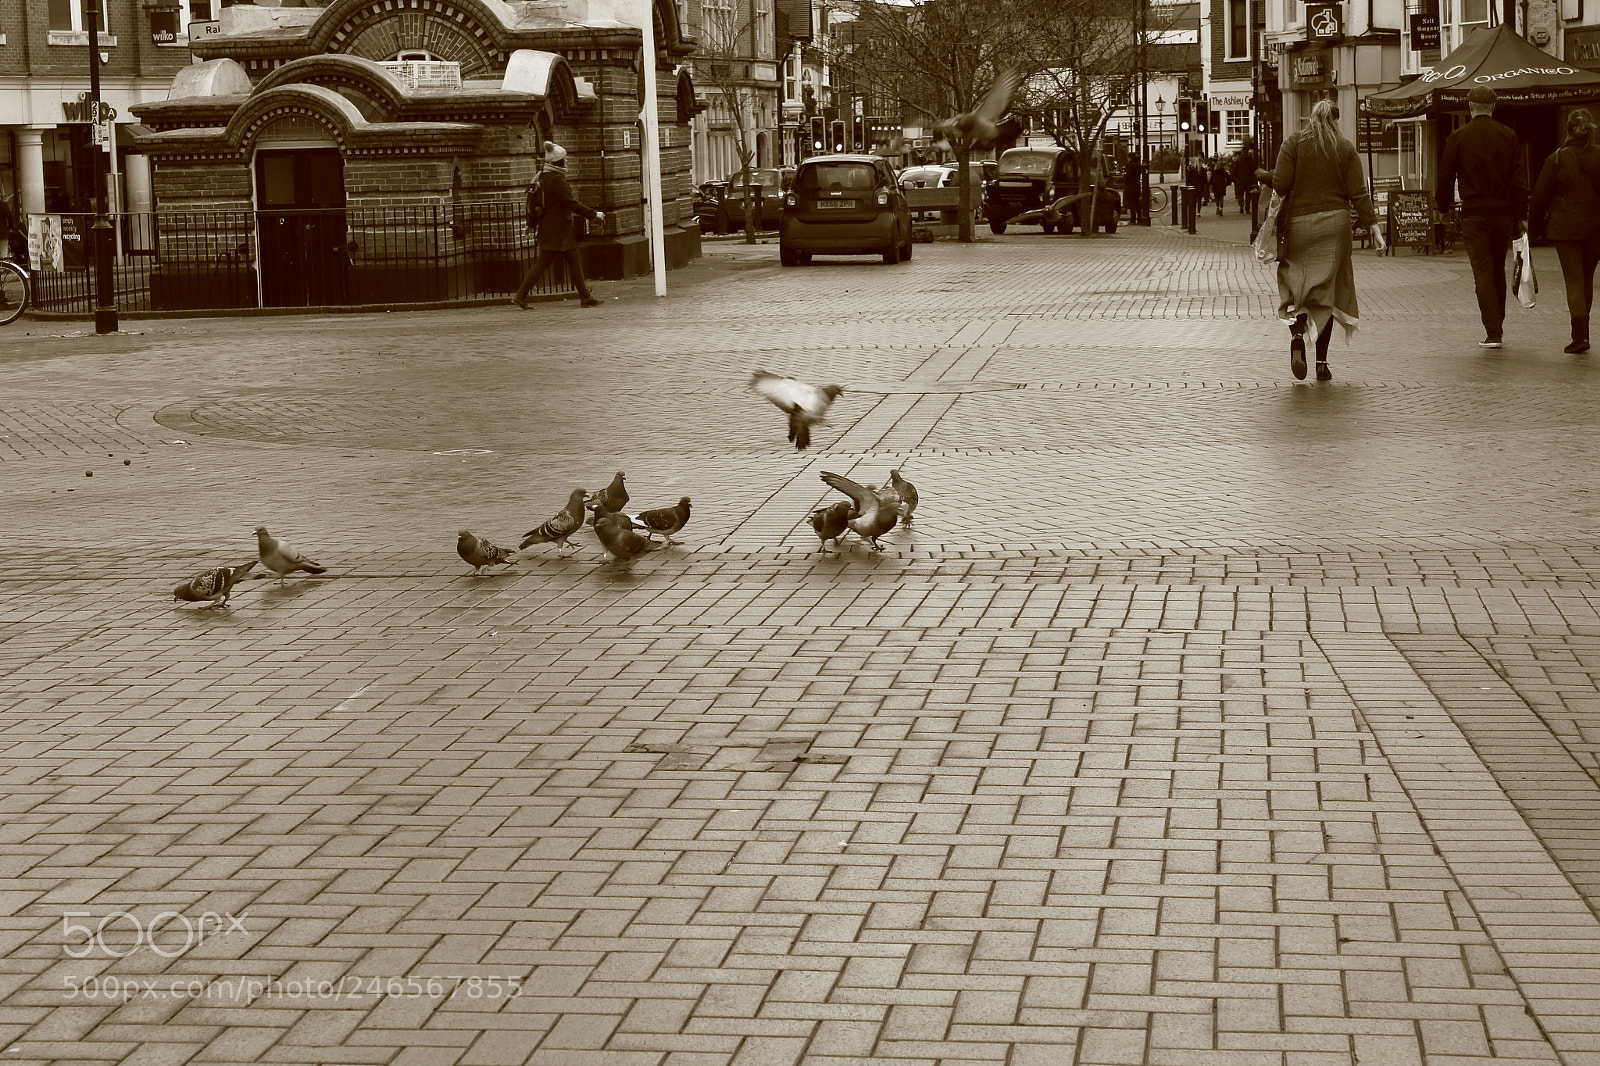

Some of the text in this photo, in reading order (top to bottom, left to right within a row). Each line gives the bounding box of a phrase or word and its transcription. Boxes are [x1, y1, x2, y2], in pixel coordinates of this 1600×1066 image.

[152, 29, 174, 41] wilko
[62, 91, 110, 122] wilo
[1212, 96, 1223, 106] The
[1223, 95, 1244, 108] Ashley
